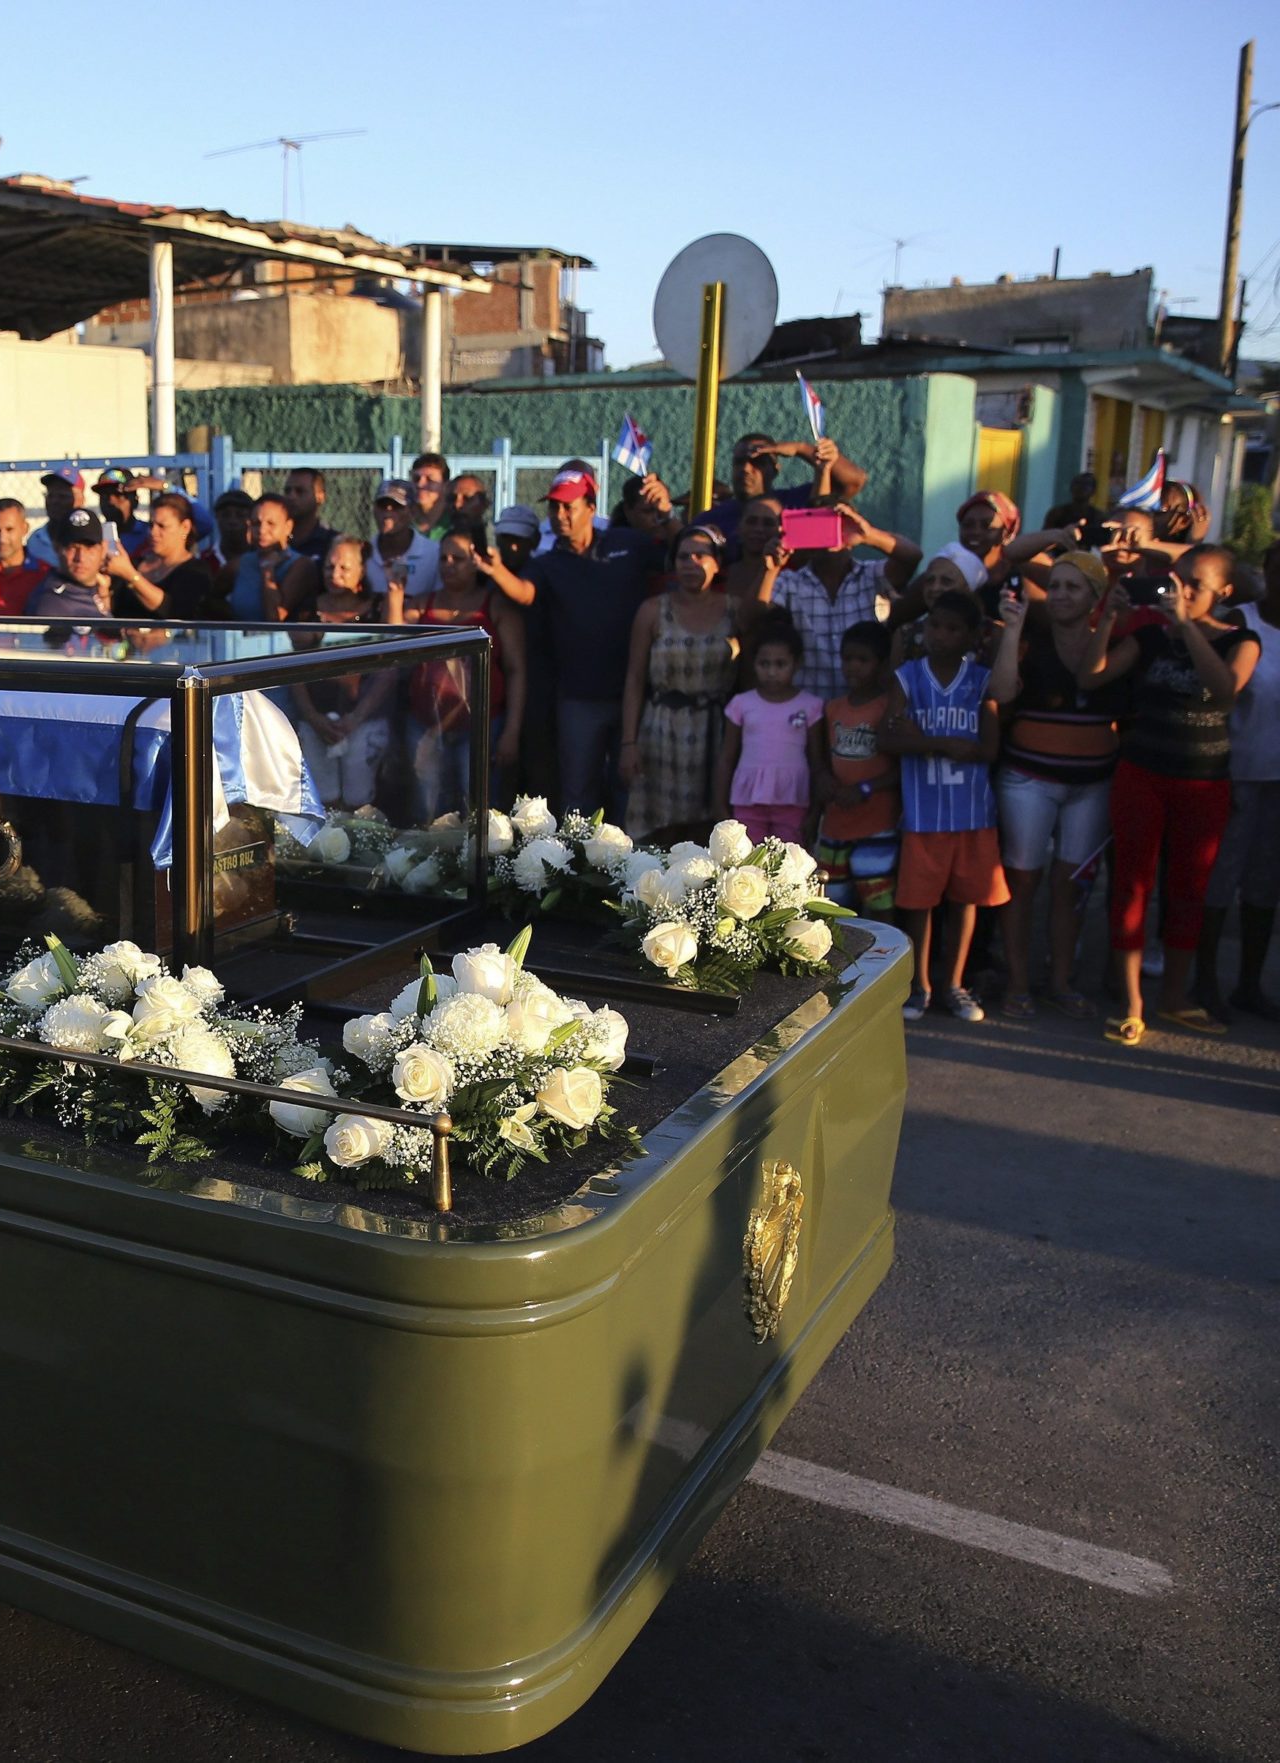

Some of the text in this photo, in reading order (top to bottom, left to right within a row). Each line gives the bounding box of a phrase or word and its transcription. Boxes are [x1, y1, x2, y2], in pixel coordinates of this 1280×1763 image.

[913, 706, 978, 733] RLANDO
[213, 850, 254, 873] ASTRO RUZ
